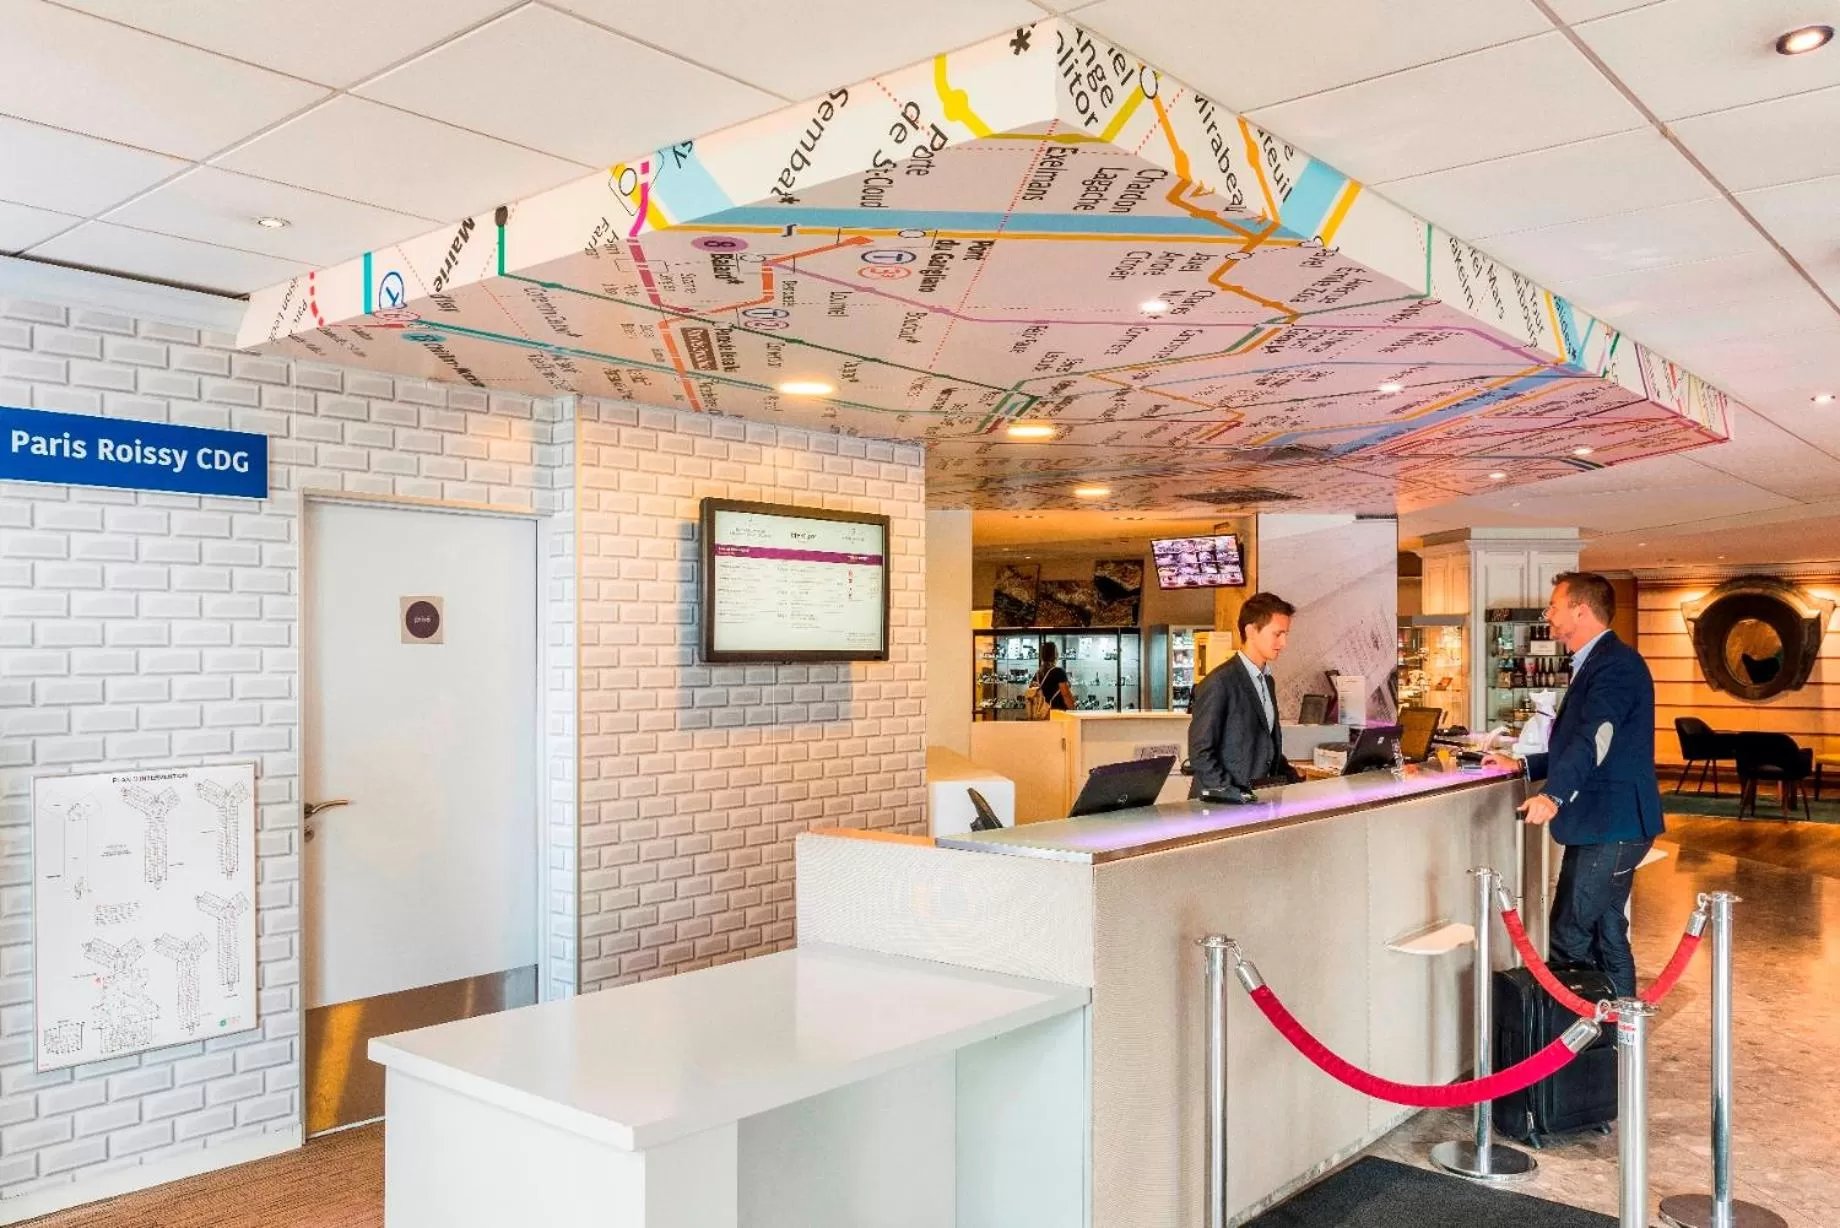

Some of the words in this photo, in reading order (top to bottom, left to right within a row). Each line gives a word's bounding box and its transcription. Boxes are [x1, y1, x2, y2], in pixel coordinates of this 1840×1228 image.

[890, 101, 921, 144] de
[906, 123, 948, 177] Porte
[1022, 146, 1079, 202] Exelmans
[1073, 167, 1129, 211] Lagache
[1109, 168, 1168, 214] Chardon
[433, 217, 475, 293] Mairie
[919, 251, 955, 292] Garigliano
[963, 239, 997, 261] Pont
[11, 429, 88, 459] Paris
[97, 438, 189, 473] Roissy
[196, 447, 250, 473] CDG
